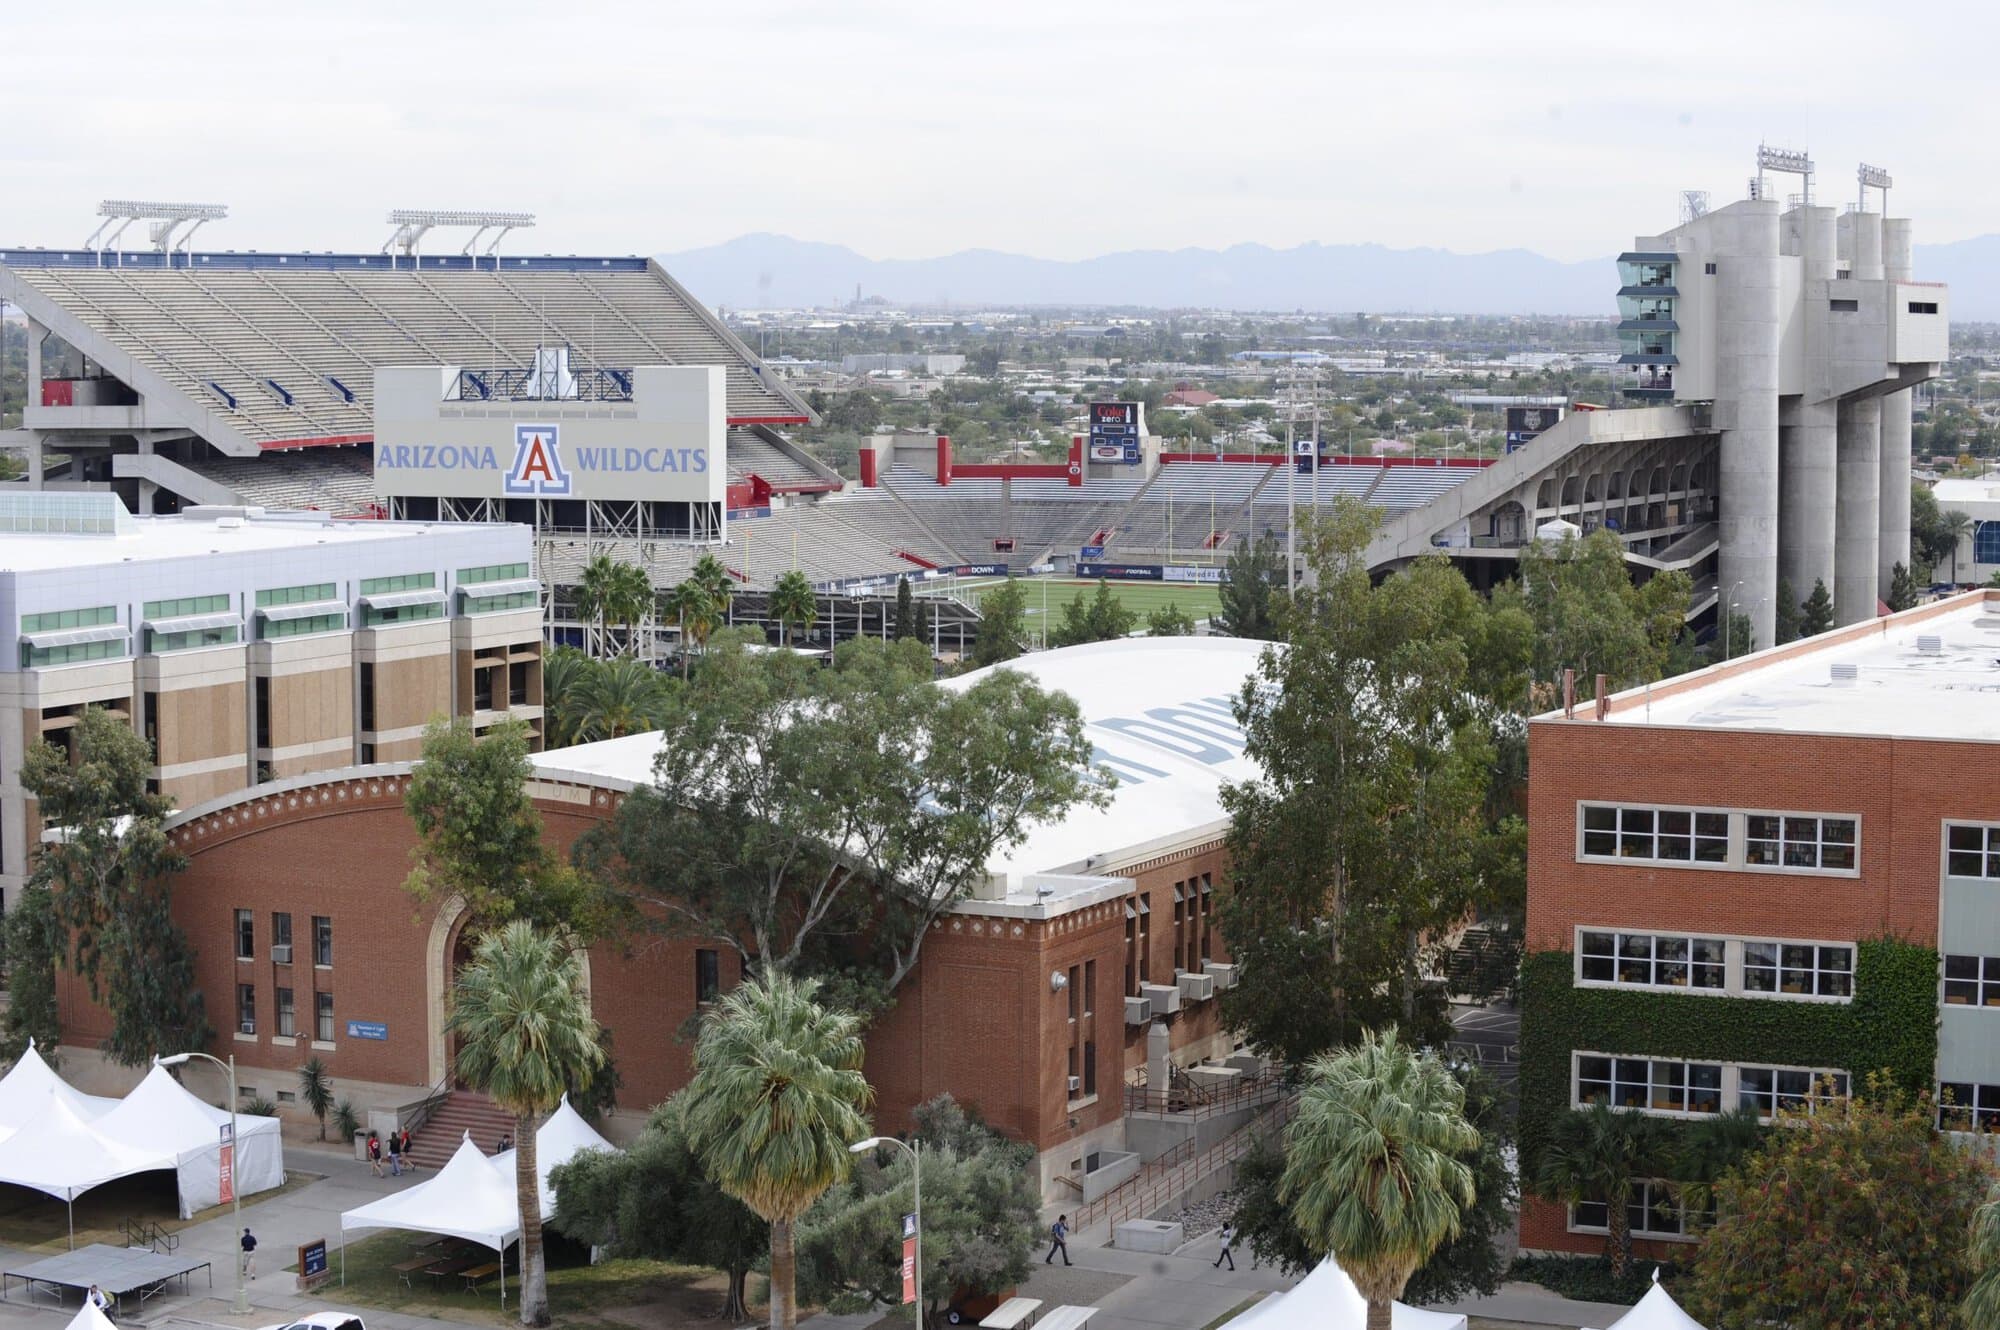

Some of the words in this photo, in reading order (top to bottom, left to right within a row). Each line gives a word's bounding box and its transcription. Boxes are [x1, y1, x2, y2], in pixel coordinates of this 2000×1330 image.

[1098, 405, 1124, 417] Coke
[377, 444, 498, 470] ARIZONA
[504, 425, 571, 494] A
[576, 447, 707, 473] WILDCATS
[1186, 570, 1206, 578] Voed
